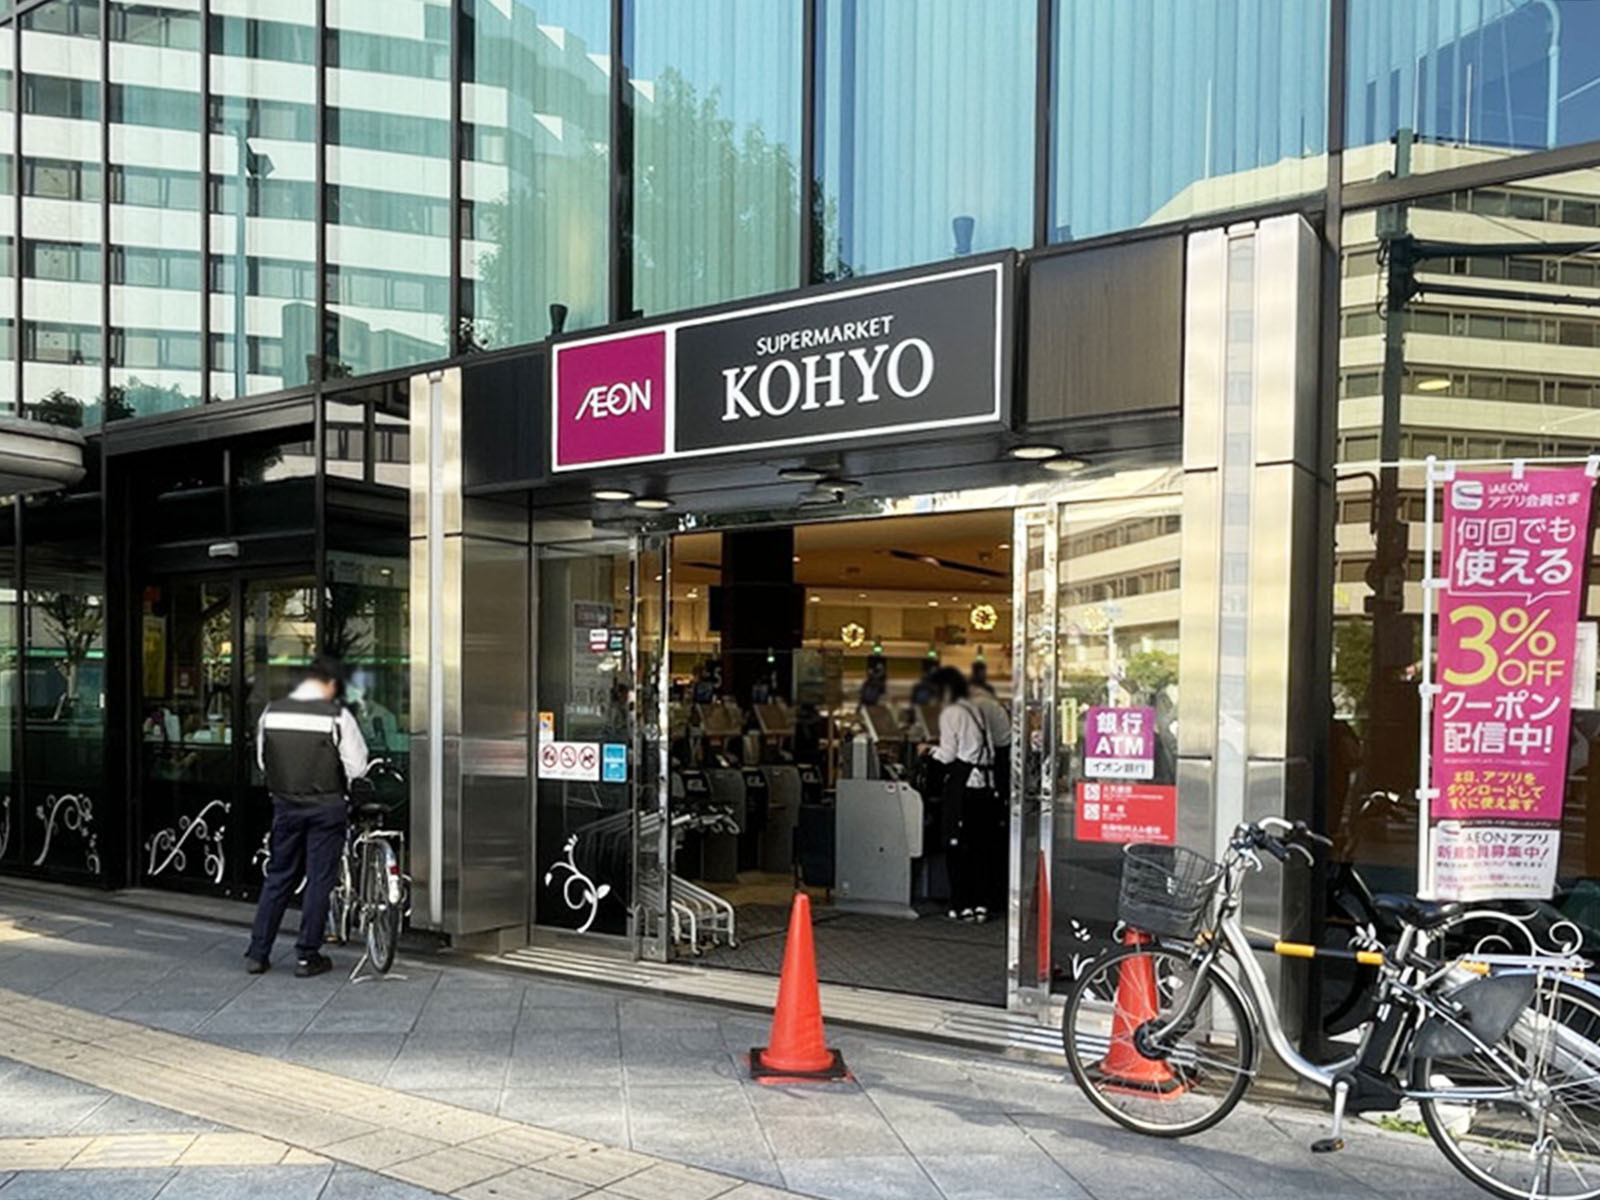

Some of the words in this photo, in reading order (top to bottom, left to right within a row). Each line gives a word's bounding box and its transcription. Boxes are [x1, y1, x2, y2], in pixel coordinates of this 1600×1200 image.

[757, 315, 893, 355] SUPERMARKET
[722, 337, 934, 421] KOHYO
[1488, 492, 1580, 509] アプリ会員さま
[1457, 516, 1576, 546] 何回でも
[1456, 548, 1574, 587] 使える
[1443, 605, 1557, 686] 3%
[1497, 658, 1565, 687] OFF
[1441, 690, 1561, 721] クーポン
[1096, 712, 1144, 735] 銀行
[1095, 736, 1144, 756] ATM
[1093, 762, 1146, 774] イオン銀行
[1447, 783, 1545, 799] ダウンロードして
